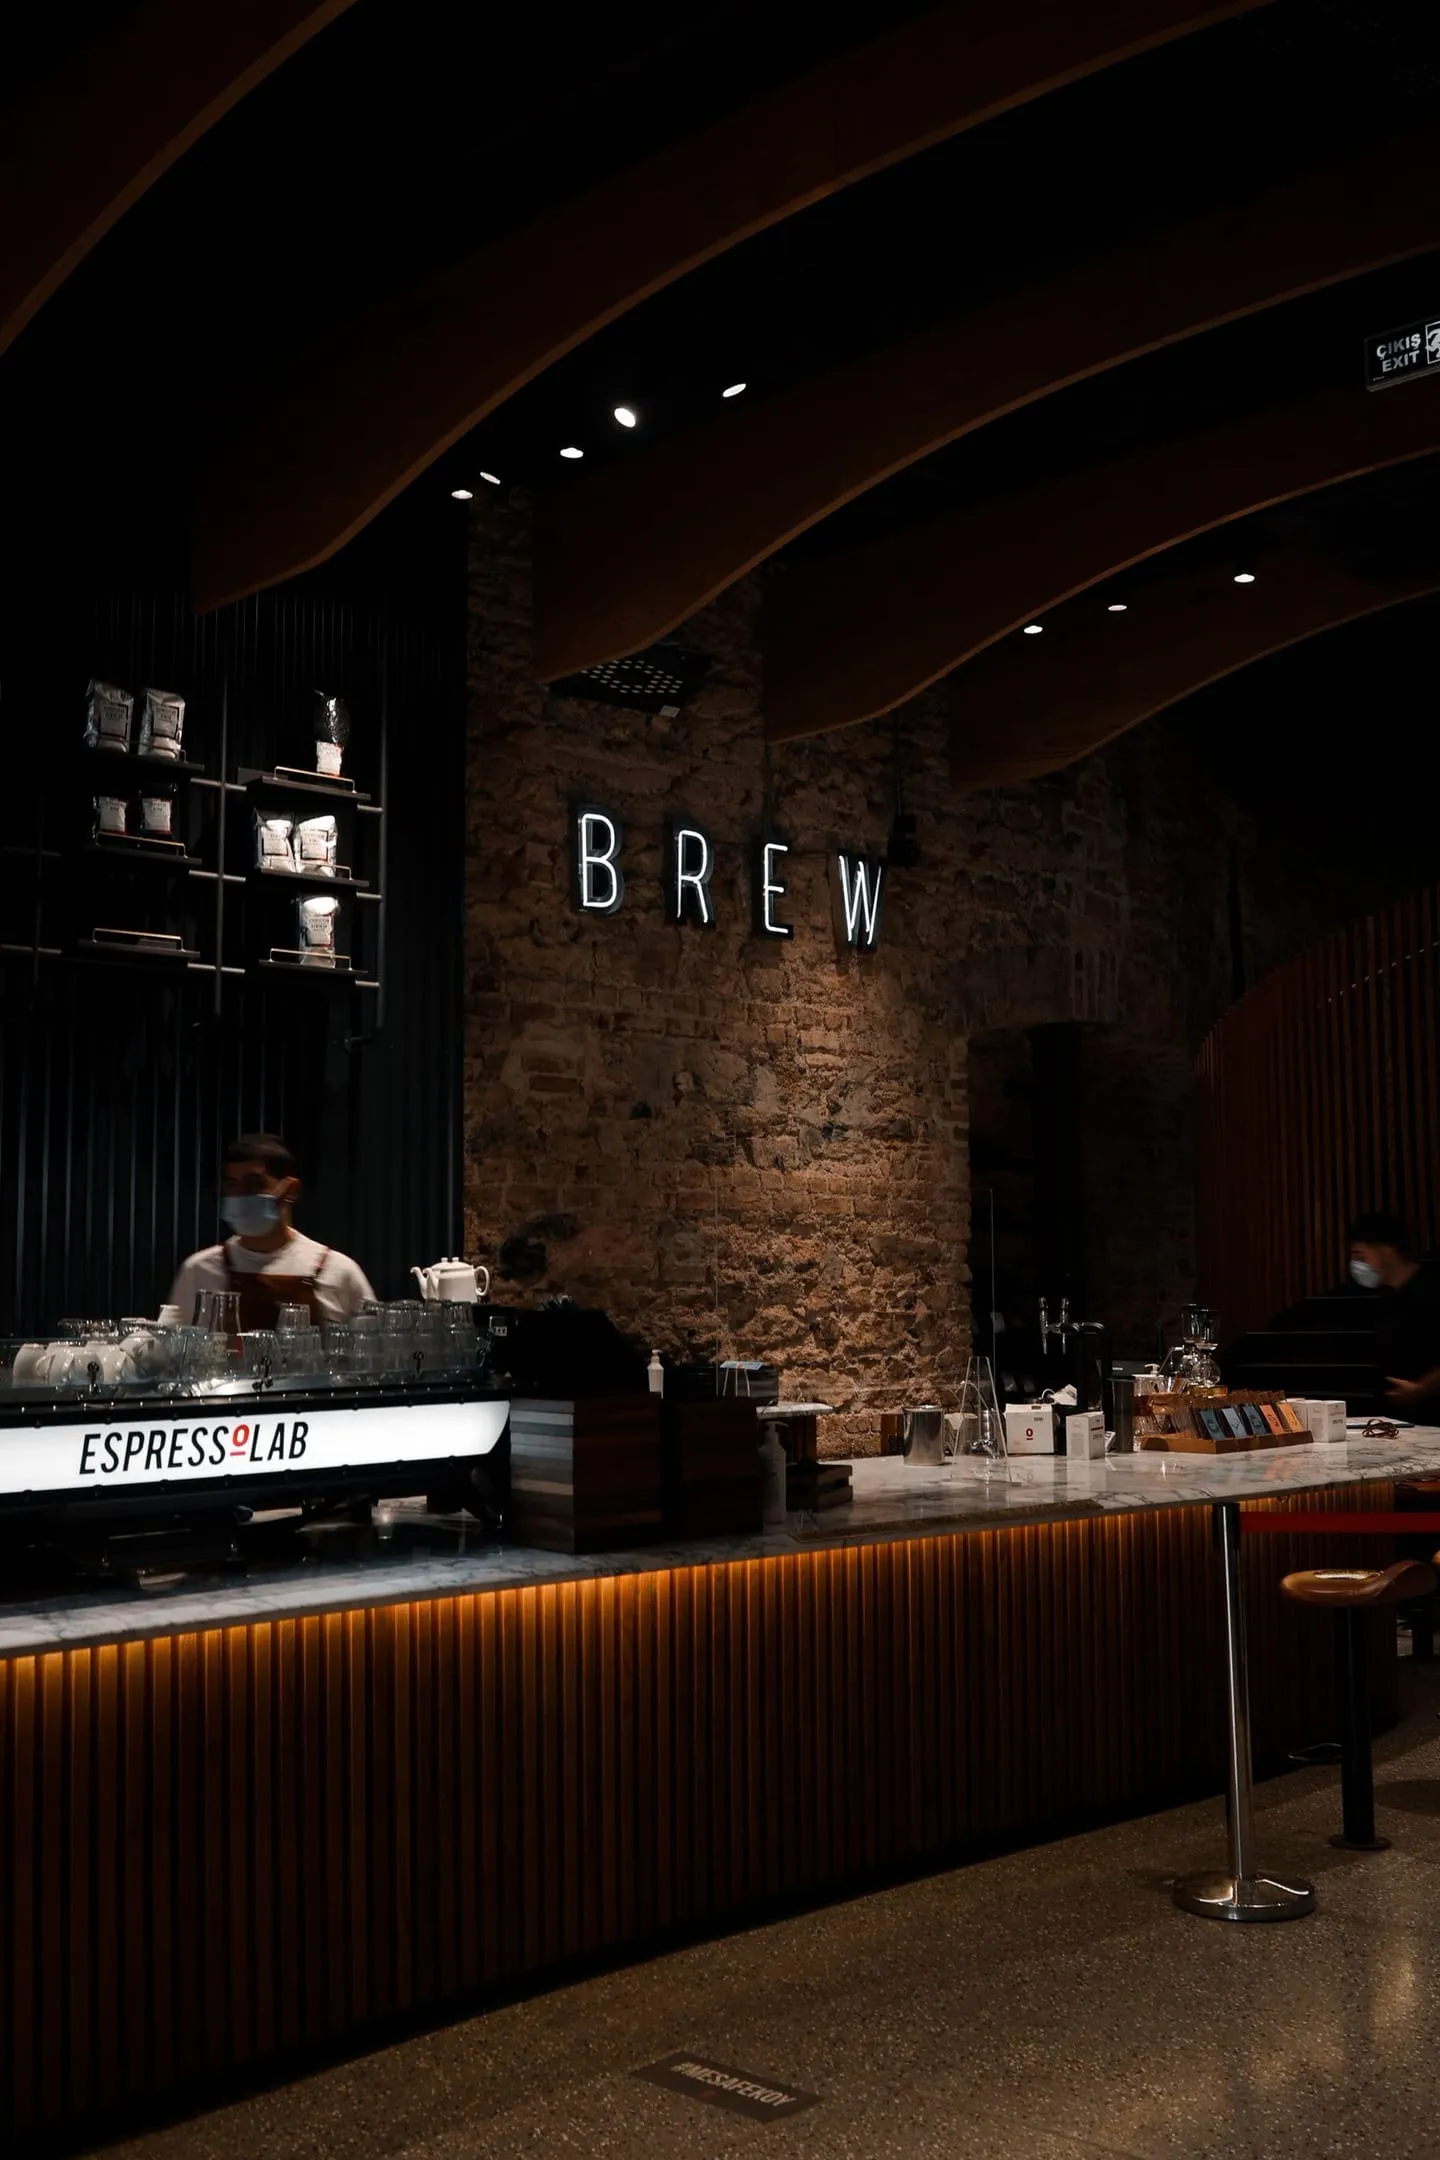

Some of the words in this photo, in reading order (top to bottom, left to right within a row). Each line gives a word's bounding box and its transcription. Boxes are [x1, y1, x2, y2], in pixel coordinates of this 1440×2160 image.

[1382, 350, 1421, 373] EXIT
[577, 812, 882, 947] BREW
[79, 1421, 309, 1475] ESPRESSOLAB
